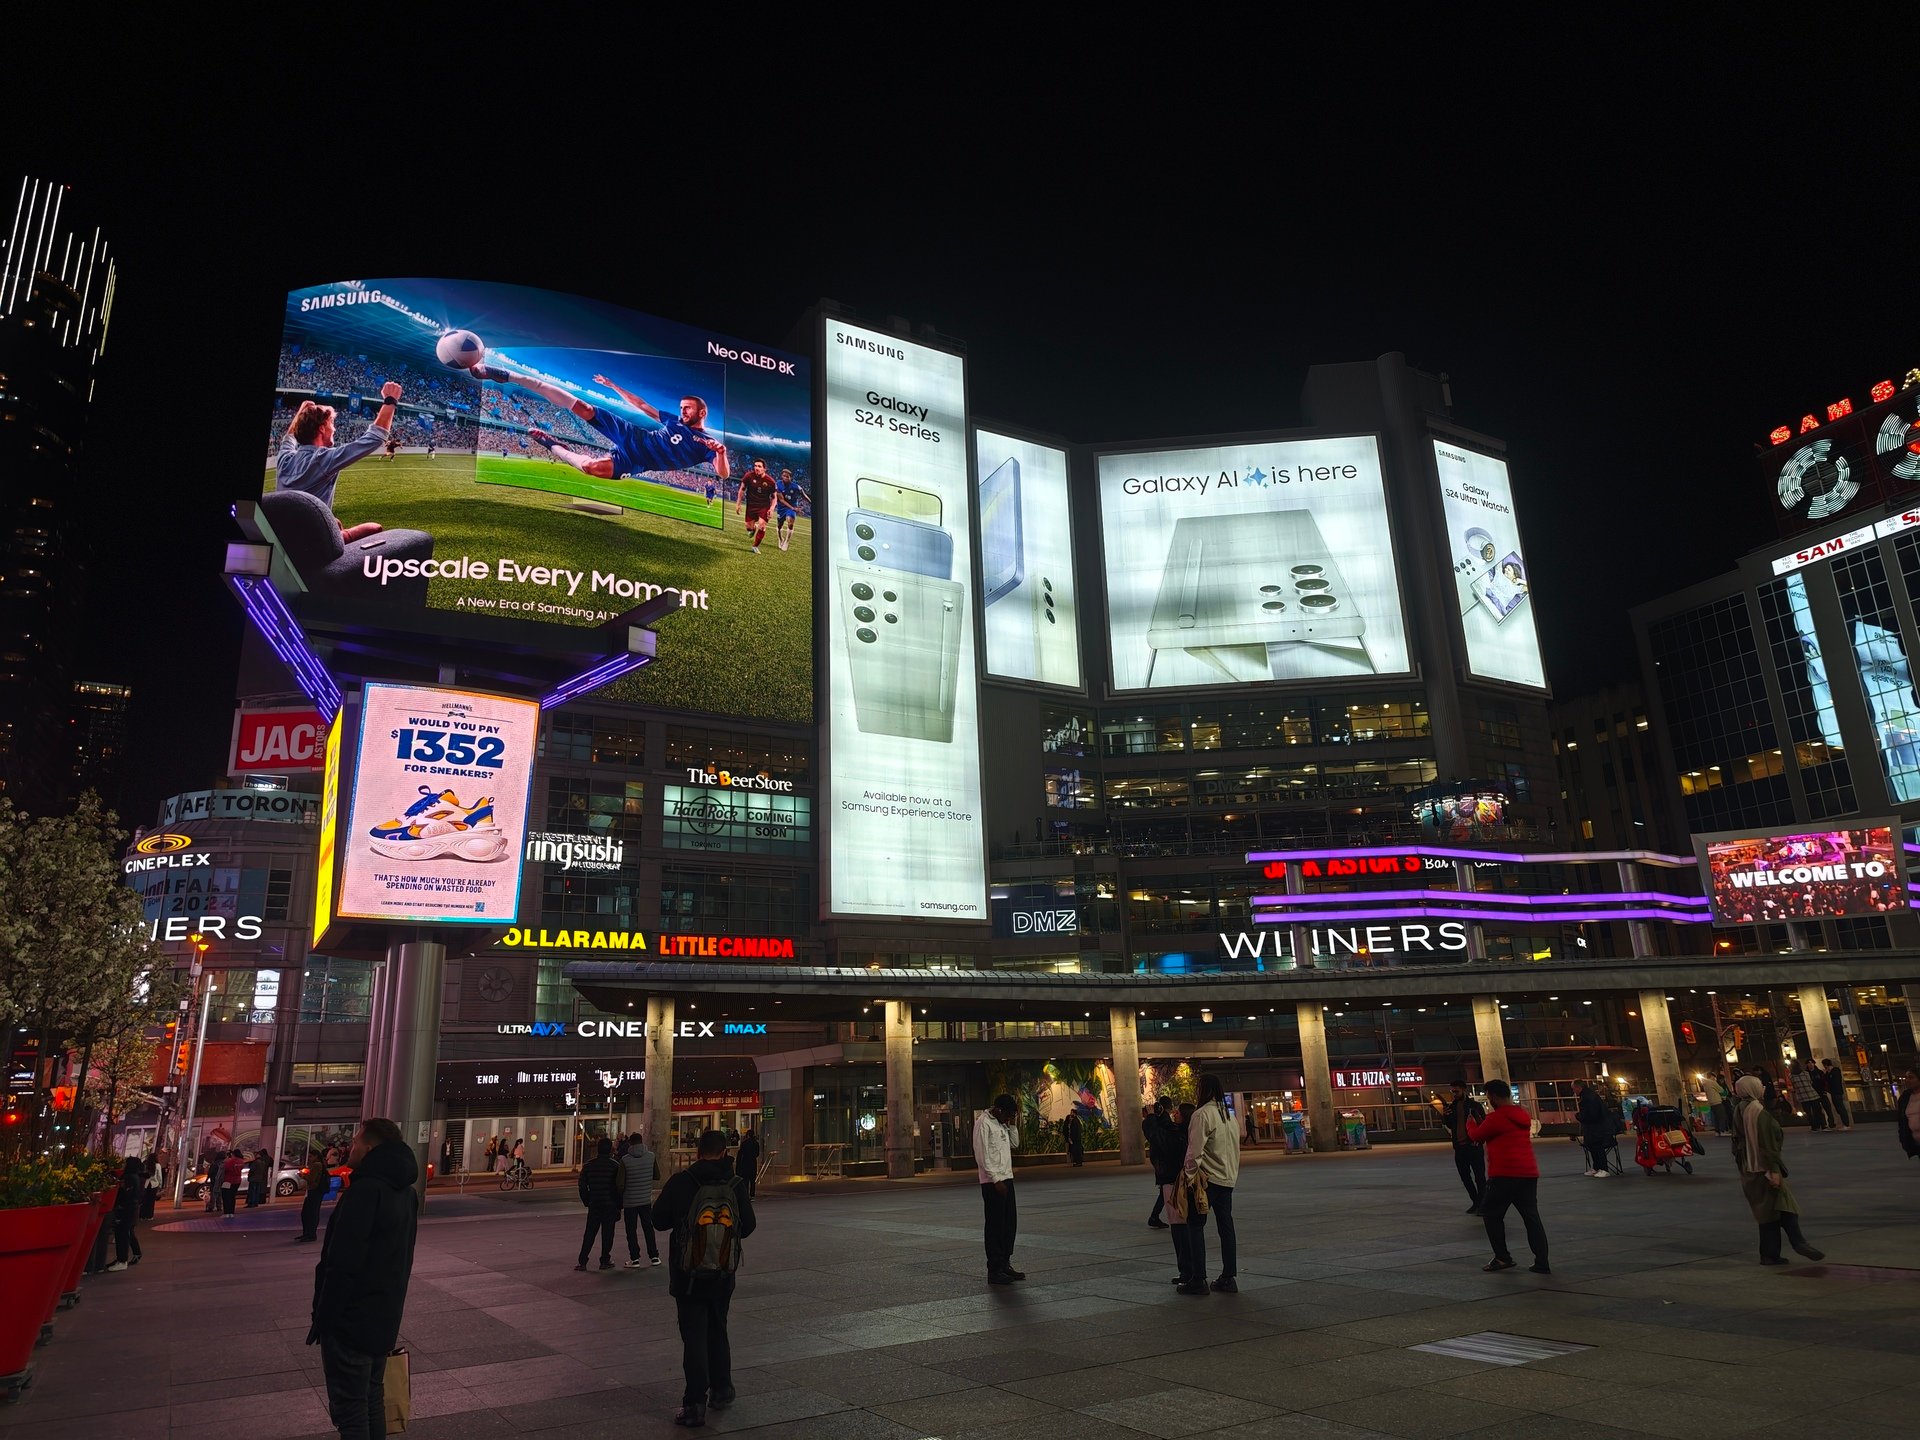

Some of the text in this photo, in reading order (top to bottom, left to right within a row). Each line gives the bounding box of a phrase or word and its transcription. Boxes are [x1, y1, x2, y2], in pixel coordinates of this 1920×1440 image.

[300, 289, 381, 312] SAMSUNG
[836, 332, 904, 361] SAMSUNG
[707, 341, 795, 376] Neo QLED 8K
[866, 391, 928, 422] Galaxy
[855, 408, 940, 443] S24 Series
[1438, 449, 1466, 463] SAMSUNG
[1122, 464, 1357, 495] Galaxy AI is here
[1445, 488, 1509, 514] S24 Ultra Watch6
[1462, 482, 1489, 499] Galaxy
[1796, 538, 1844, 565] SAM
[363, 555, 709, 610] Upscale Every Momnt
[456, 597, 466, 606] A
[467, 597, 496, 608] New
[499, 599, 519, 610] Era
[522, 600, 536, 611] of
[537, 602, 594, 621] Samsung
[596, 611, 607, 620] AI
[408, 717, 500, 734] WOULD YOU PAY
[391, 728, 505, 769] $1352
[404, 764, 494, 779] FOR SNEAKERS?
[687, 768, 717, 785] The
[755, 774, 793, 792] Store
[222, 795, 322, 816] TORONT
[863, 790, 907, 803] Available
[909, 796, 930, 805] now
[933, 798, 943, 806] at
[672, 801, 739, 822] Hard Rock
[747, 811, 793, 824] COMING
[841, 800, 972, 821] Samsung Experience Store
[755, 827, 787, 838] SOON
[691, 840, 721, 849] TORONTO
[125, 853, 211, 874] CINEPLEX
[374, 873, 399, 882] THAT'S
[420, 877, 440, 885] MUCH
[442, 878, 466, 886] YOU'RE
[1729, 861, 1885, 888] WELCOME TO
[386, 882, 484, 894] SPENDING ON WASTED FOOD.
[920, 901, 977, 913] samsung.com
[1012, 909, 1077, 933] DMZ
[502, 927, 647, 950] OLLARAMA
[718, 937, 794, 958] CANADA
[577, 1020, 715, 1038] CINEEX
[724, 1023, 767, 1034] IMAX
[533, 1072, 577, 1083] THE TENOR
[626, 1070, 646, 1080] TENO
[1336, 1070, 1385, 1087] BLZE PIZZA
[672, 1096, 704, 1106] CANADA
